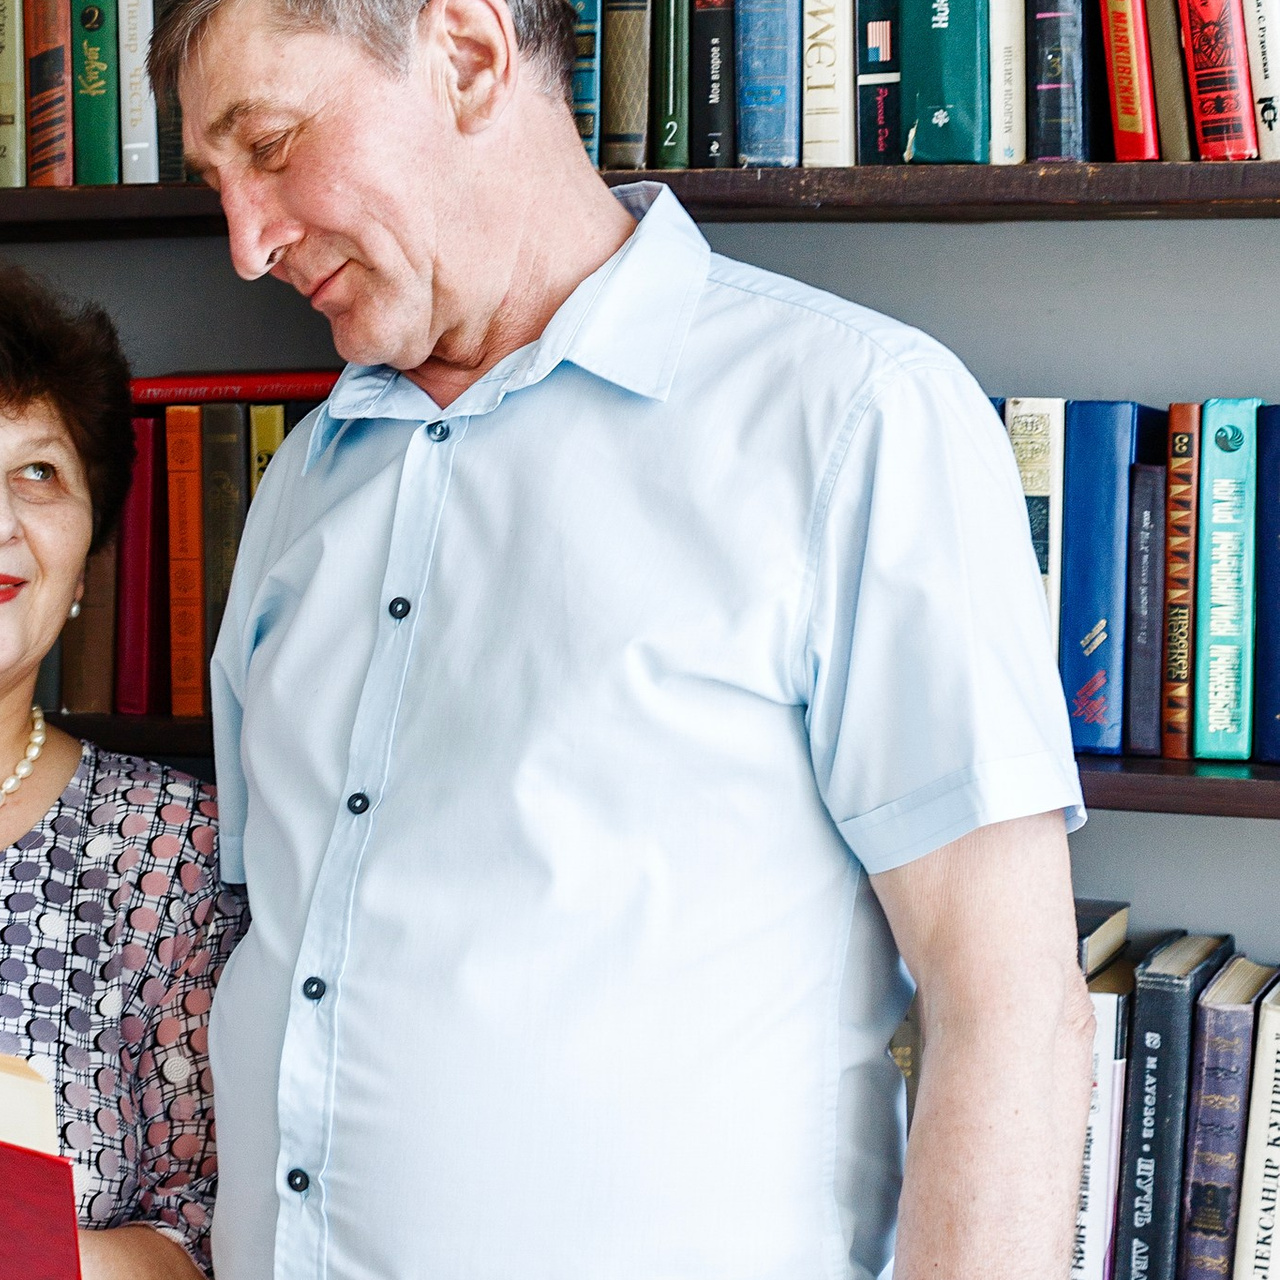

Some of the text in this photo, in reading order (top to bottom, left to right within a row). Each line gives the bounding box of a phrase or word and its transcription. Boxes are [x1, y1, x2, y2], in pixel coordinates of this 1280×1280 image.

[78, 39, 108, 96] Кнут
[708, 45, 722, 80] второе
[1001, 45, 1014, 86] ЖИЗНИ
[1111, 11, 1139, 116] МАЯКОВСКИЙ
[1209, 478, 1245, 733] ЗАРУБЕЖНЫЙ КРИМИНАЛЬНЫЙ РОМАН
[1128, 1158, 1155, 1228] ПУТЬ
